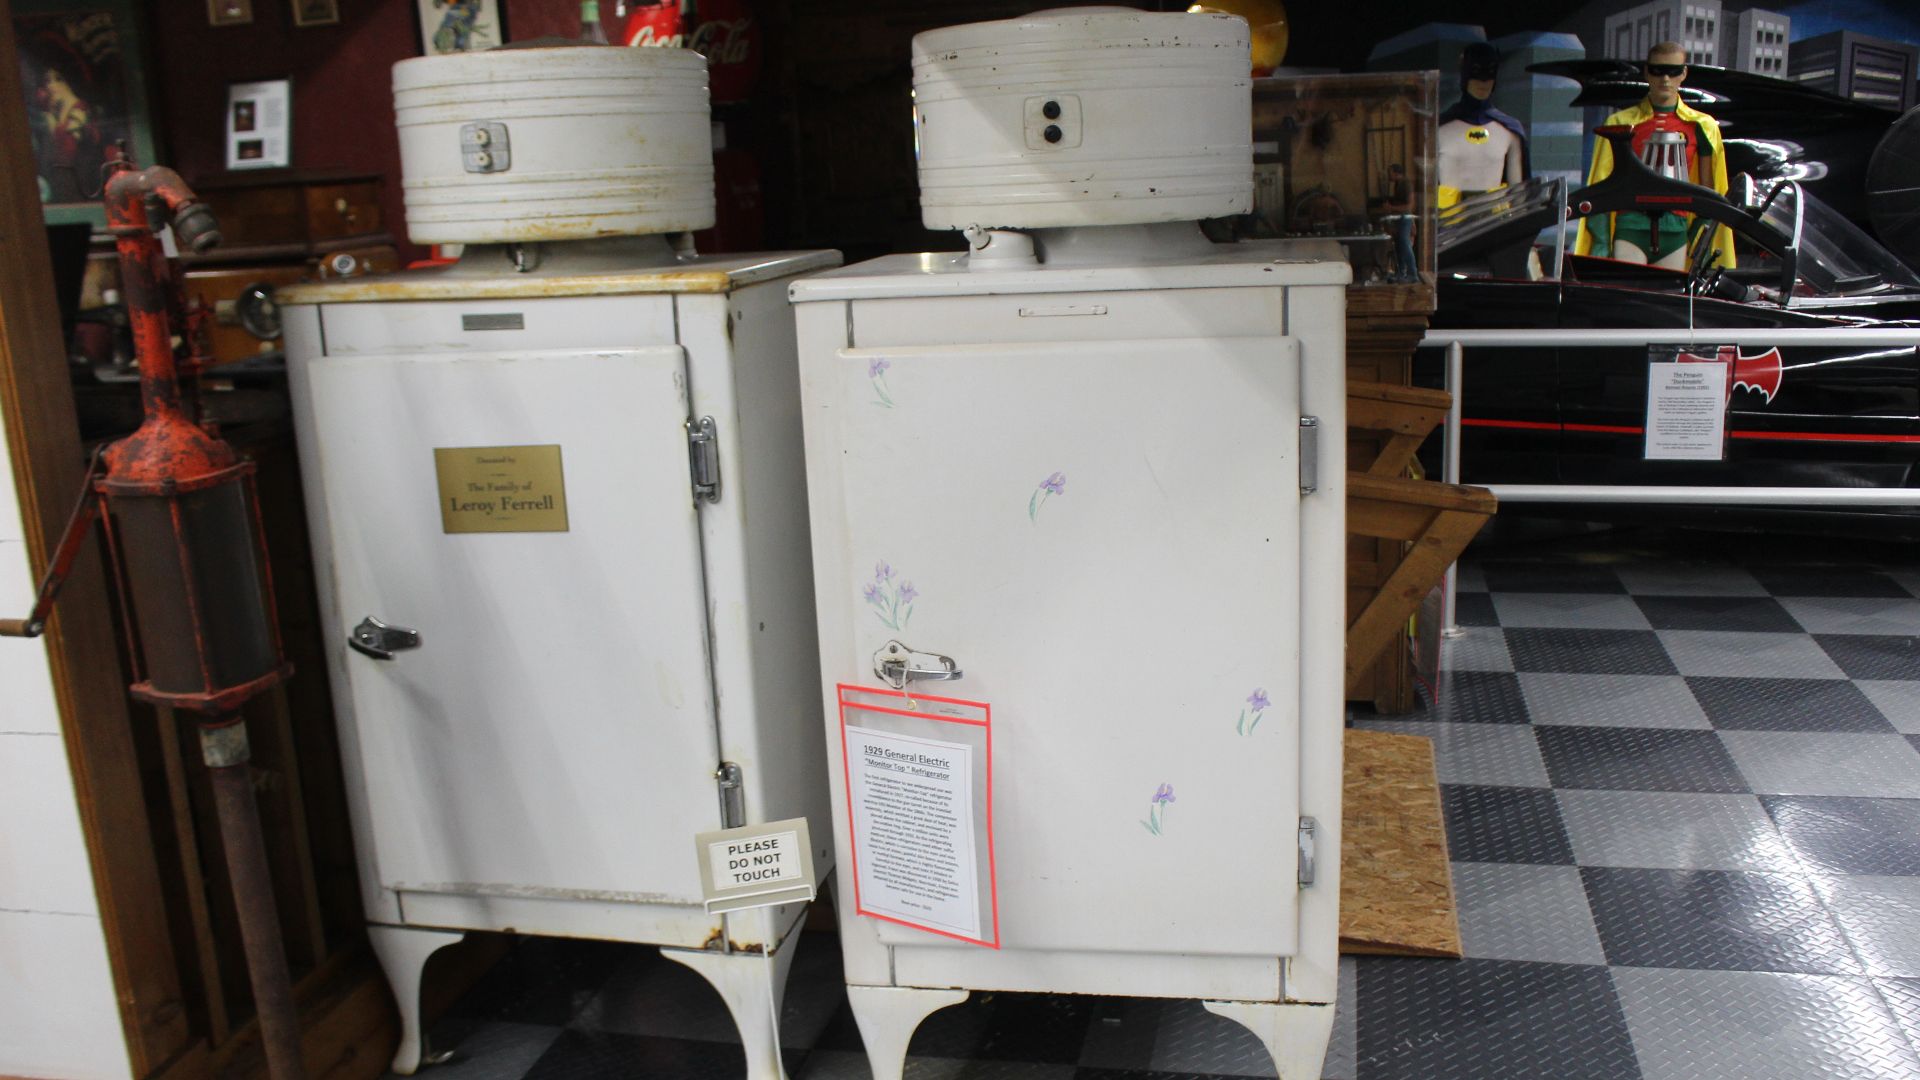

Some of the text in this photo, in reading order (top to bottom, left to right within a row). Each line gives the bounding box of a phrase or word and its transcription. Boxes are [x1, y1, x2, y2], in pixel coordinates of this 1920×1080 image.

[468, 481, 532, 493] The Family of
[451, 495, 554, 515] Leroy Ferrell
[864, 745, 950, 768] 1929 General Electric
[894, 763, 906, 772] Top
[911, 766, 950, 779] Refrigerator
[728, 839, 779, 856] PLEASE
[729, 853, 782, 870] DO NOT
[733, 868, 780, 883] TOUCH
